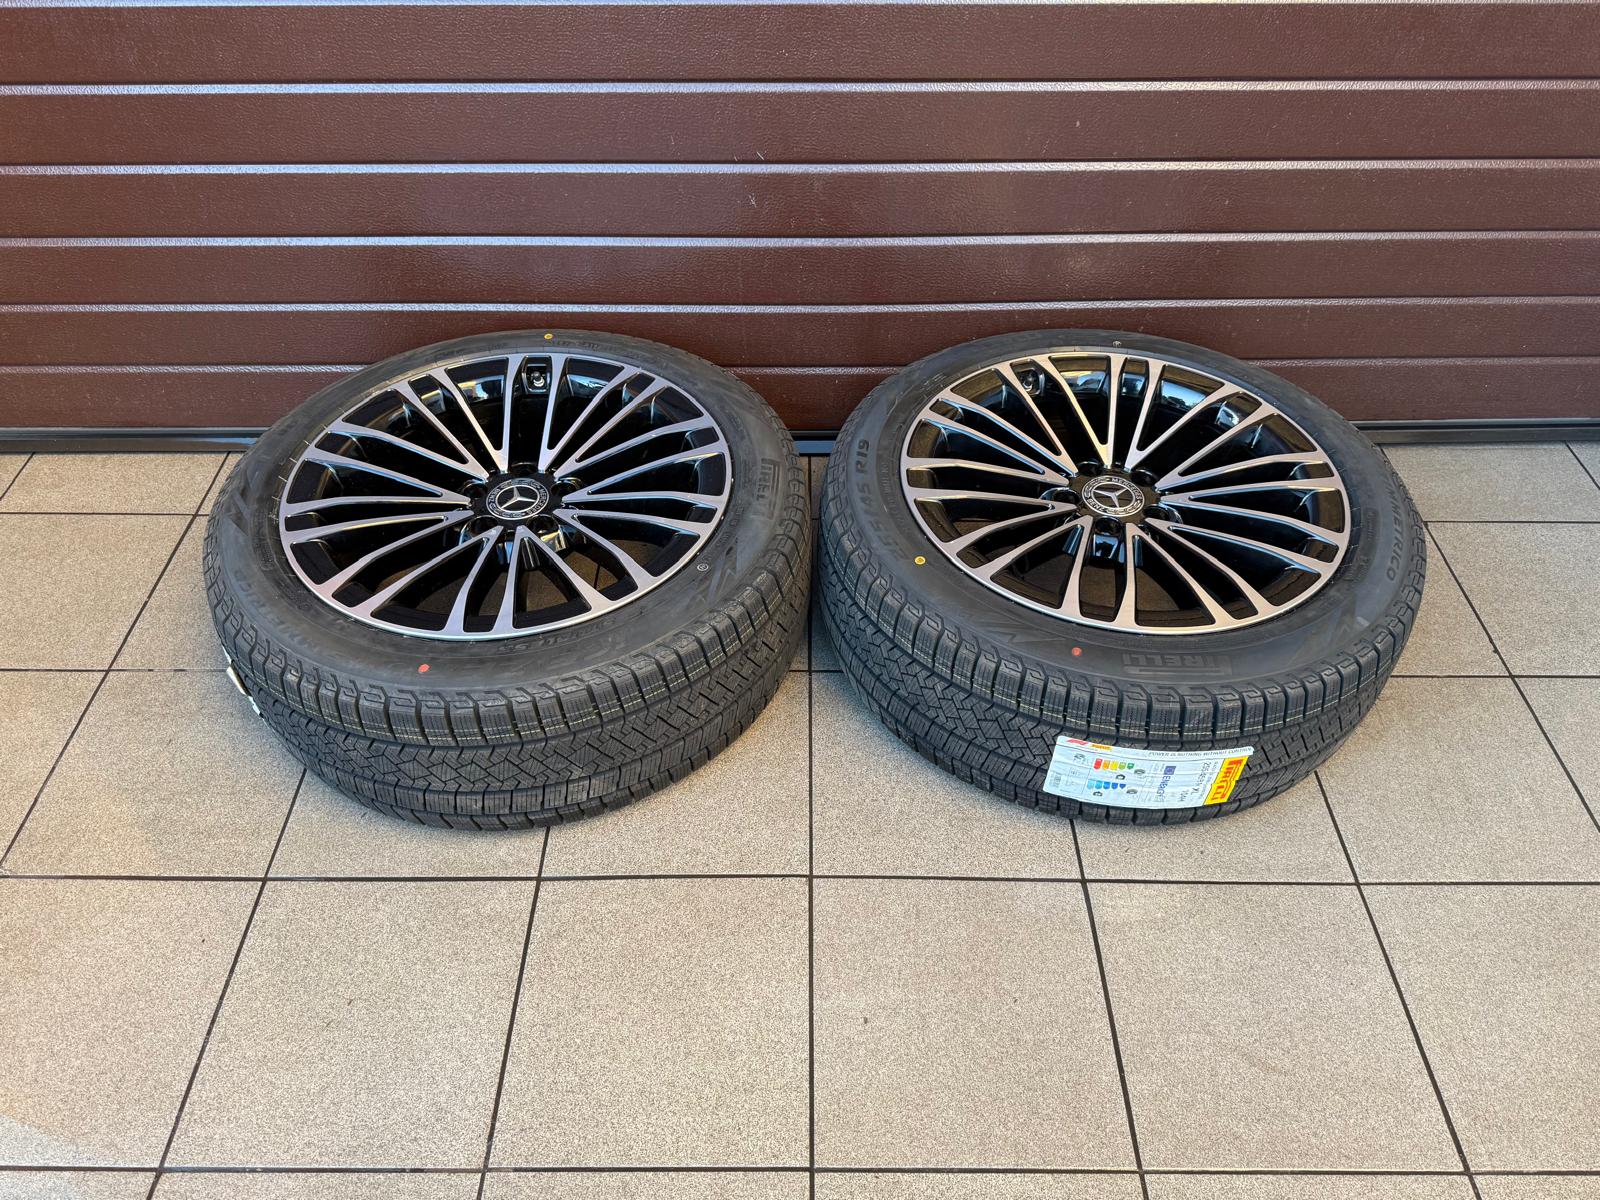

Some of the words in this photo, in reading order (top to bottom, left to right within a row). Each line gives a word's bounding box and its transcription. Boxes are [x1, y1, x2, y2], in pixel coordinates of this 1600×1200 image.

[855, 439, 870, 474] R19
[488, 488, 501, 503] BENZ
[1111, 477, 1143, 500] MERCEDES
[526, 488, 547, 514] MERCEDES
[1086, 498, 1107, 512] BENZ
[1122, 654, 1232, 677] PIRELLI
[1210, 758, 1244, 801] PIRELLI
